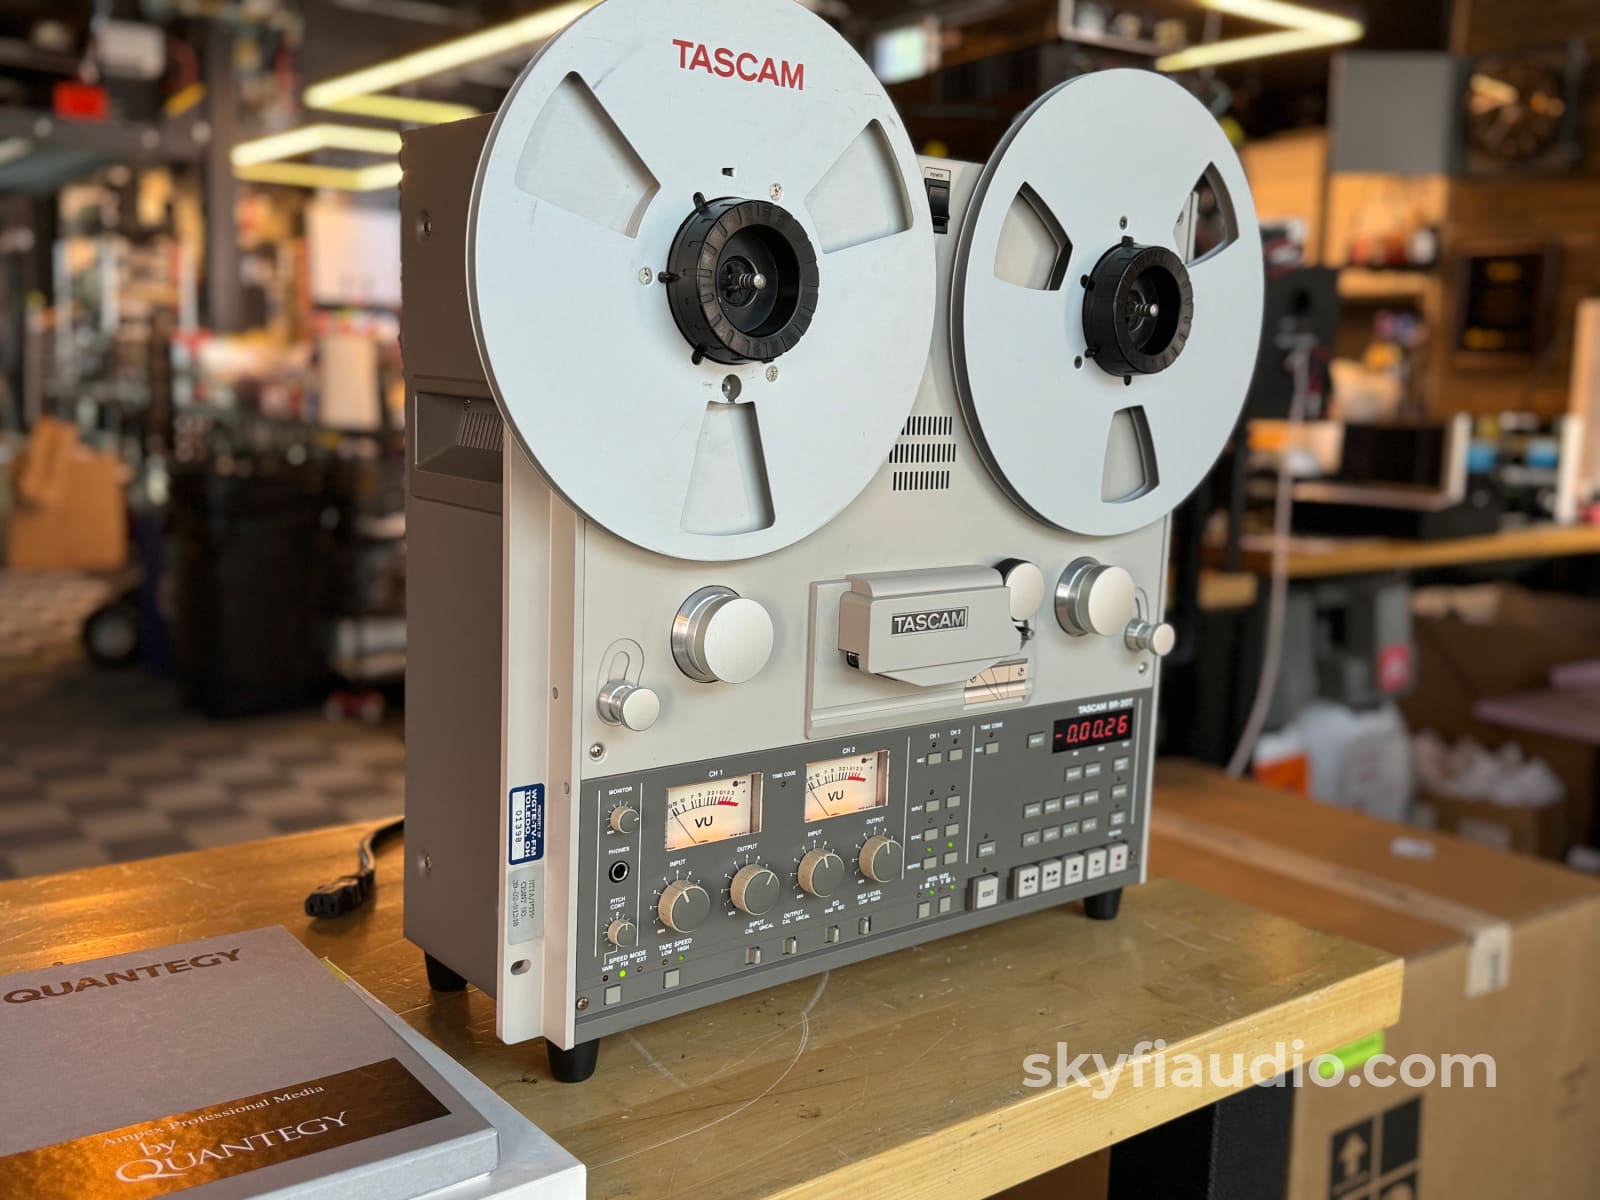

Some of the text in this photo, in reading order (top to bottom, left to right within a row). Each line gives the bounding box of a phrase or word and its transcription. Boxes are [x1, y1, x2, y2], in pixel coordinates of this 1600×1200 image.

[672, 38, 804, 90] TASCAM
[894, 609, 966, 634] TASCAM
[1078, 702, 1107, 714] TASCAM
[608, 786, 632, 795] MONITOR
[828, 790, 844, 801] VU
[694, 816, 713, 828] VU
[866, 816, 884, 825] OUTPUT
[808, 829, 822, 837] INPUT
[524, 840, 531, 857] OH
[608, 846, 630, 855] PHONES
[736, 843, 758, 852] OUTPUT
[669, 858, 686, 867] INPUT
[982, 889, 994, 898] EDIT
[610, 896, 626, 904] PITCH
[610, 902, 625, 910] CONT
[784, 909, 804, 919] OUTPUT
[749, 919, 765, 928] INPUT
[658, 938, 693, 951] TAPE SPEED
[608, 950, 647, 964] SPEED MODE
[3, 948, 241, 1004] QUANTEGY
[102, 1085, 326, 1148] Ampex Professional Media
[115, 1111, 349, 1182] QUANTEGY
[140, 1139, 177, 1157] by
